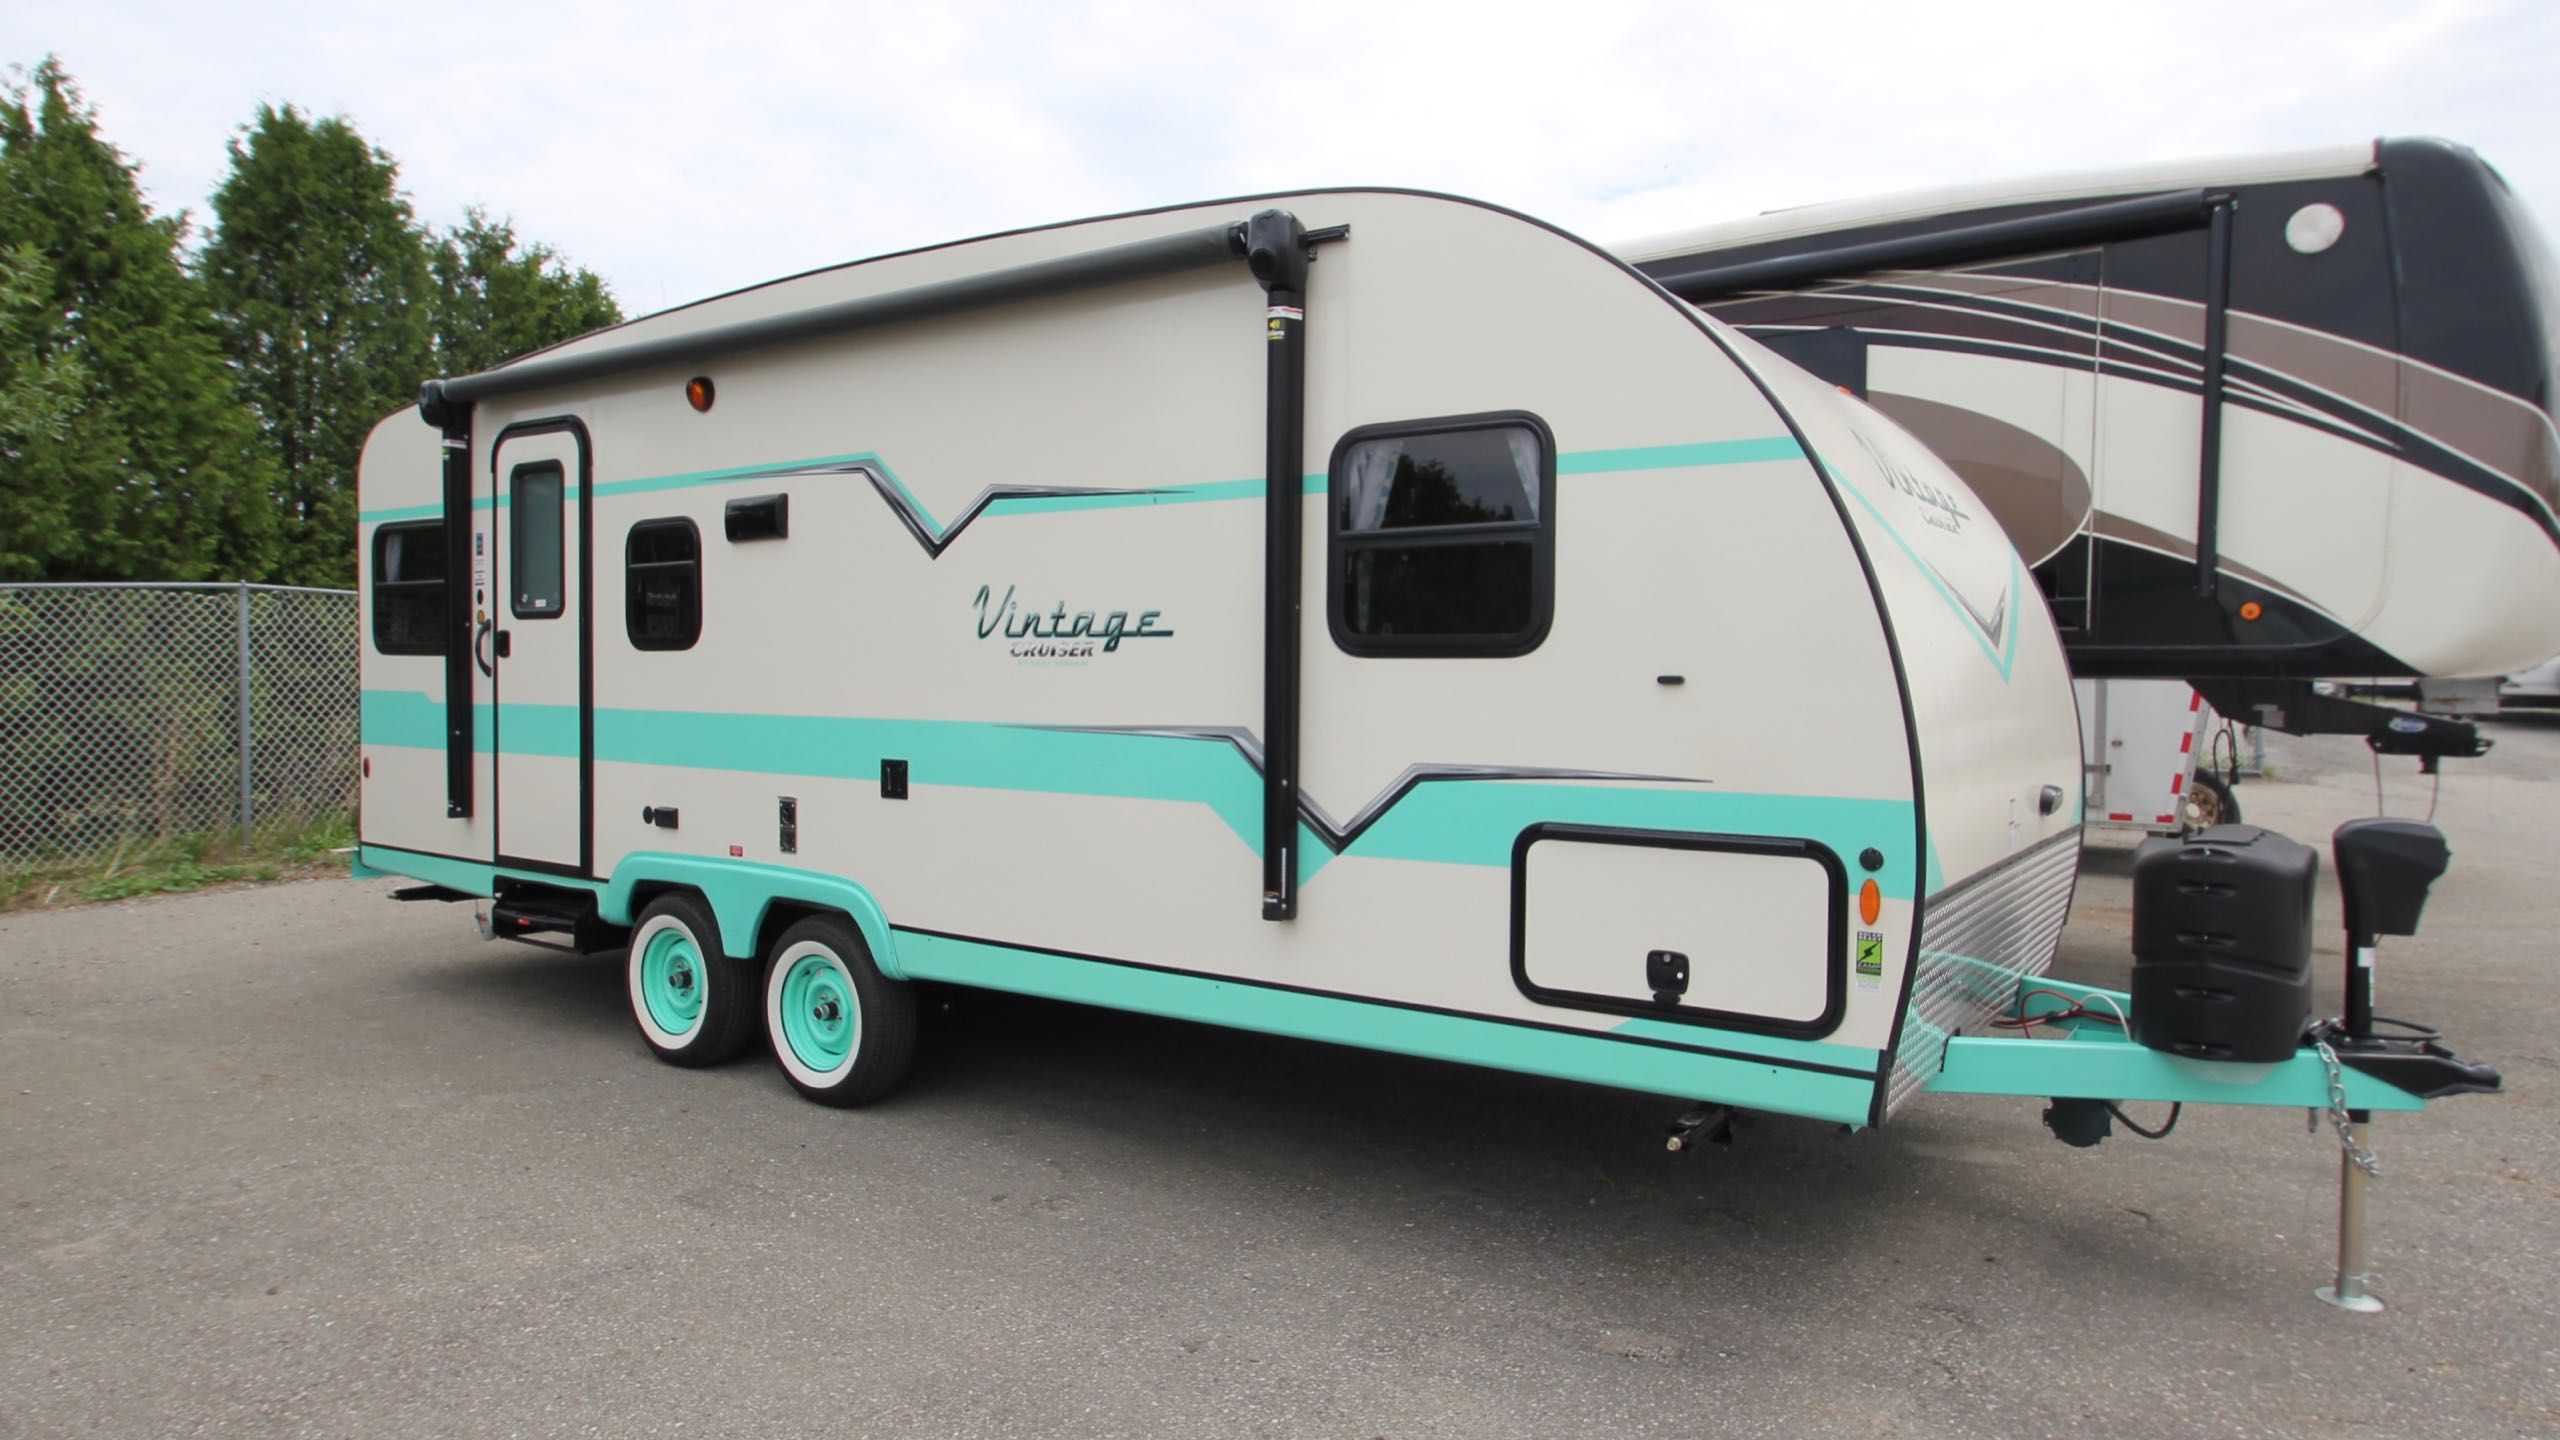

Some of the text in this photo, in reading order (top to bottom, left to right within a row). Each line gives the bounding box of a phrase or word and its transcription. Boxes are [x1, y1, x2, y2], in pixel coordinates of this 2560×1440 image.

[1849, 427, 1970, 529] Vintage
[972, 584, 1174, 652] Vintage
[1009, 641, 1095, 658] CRUISER
